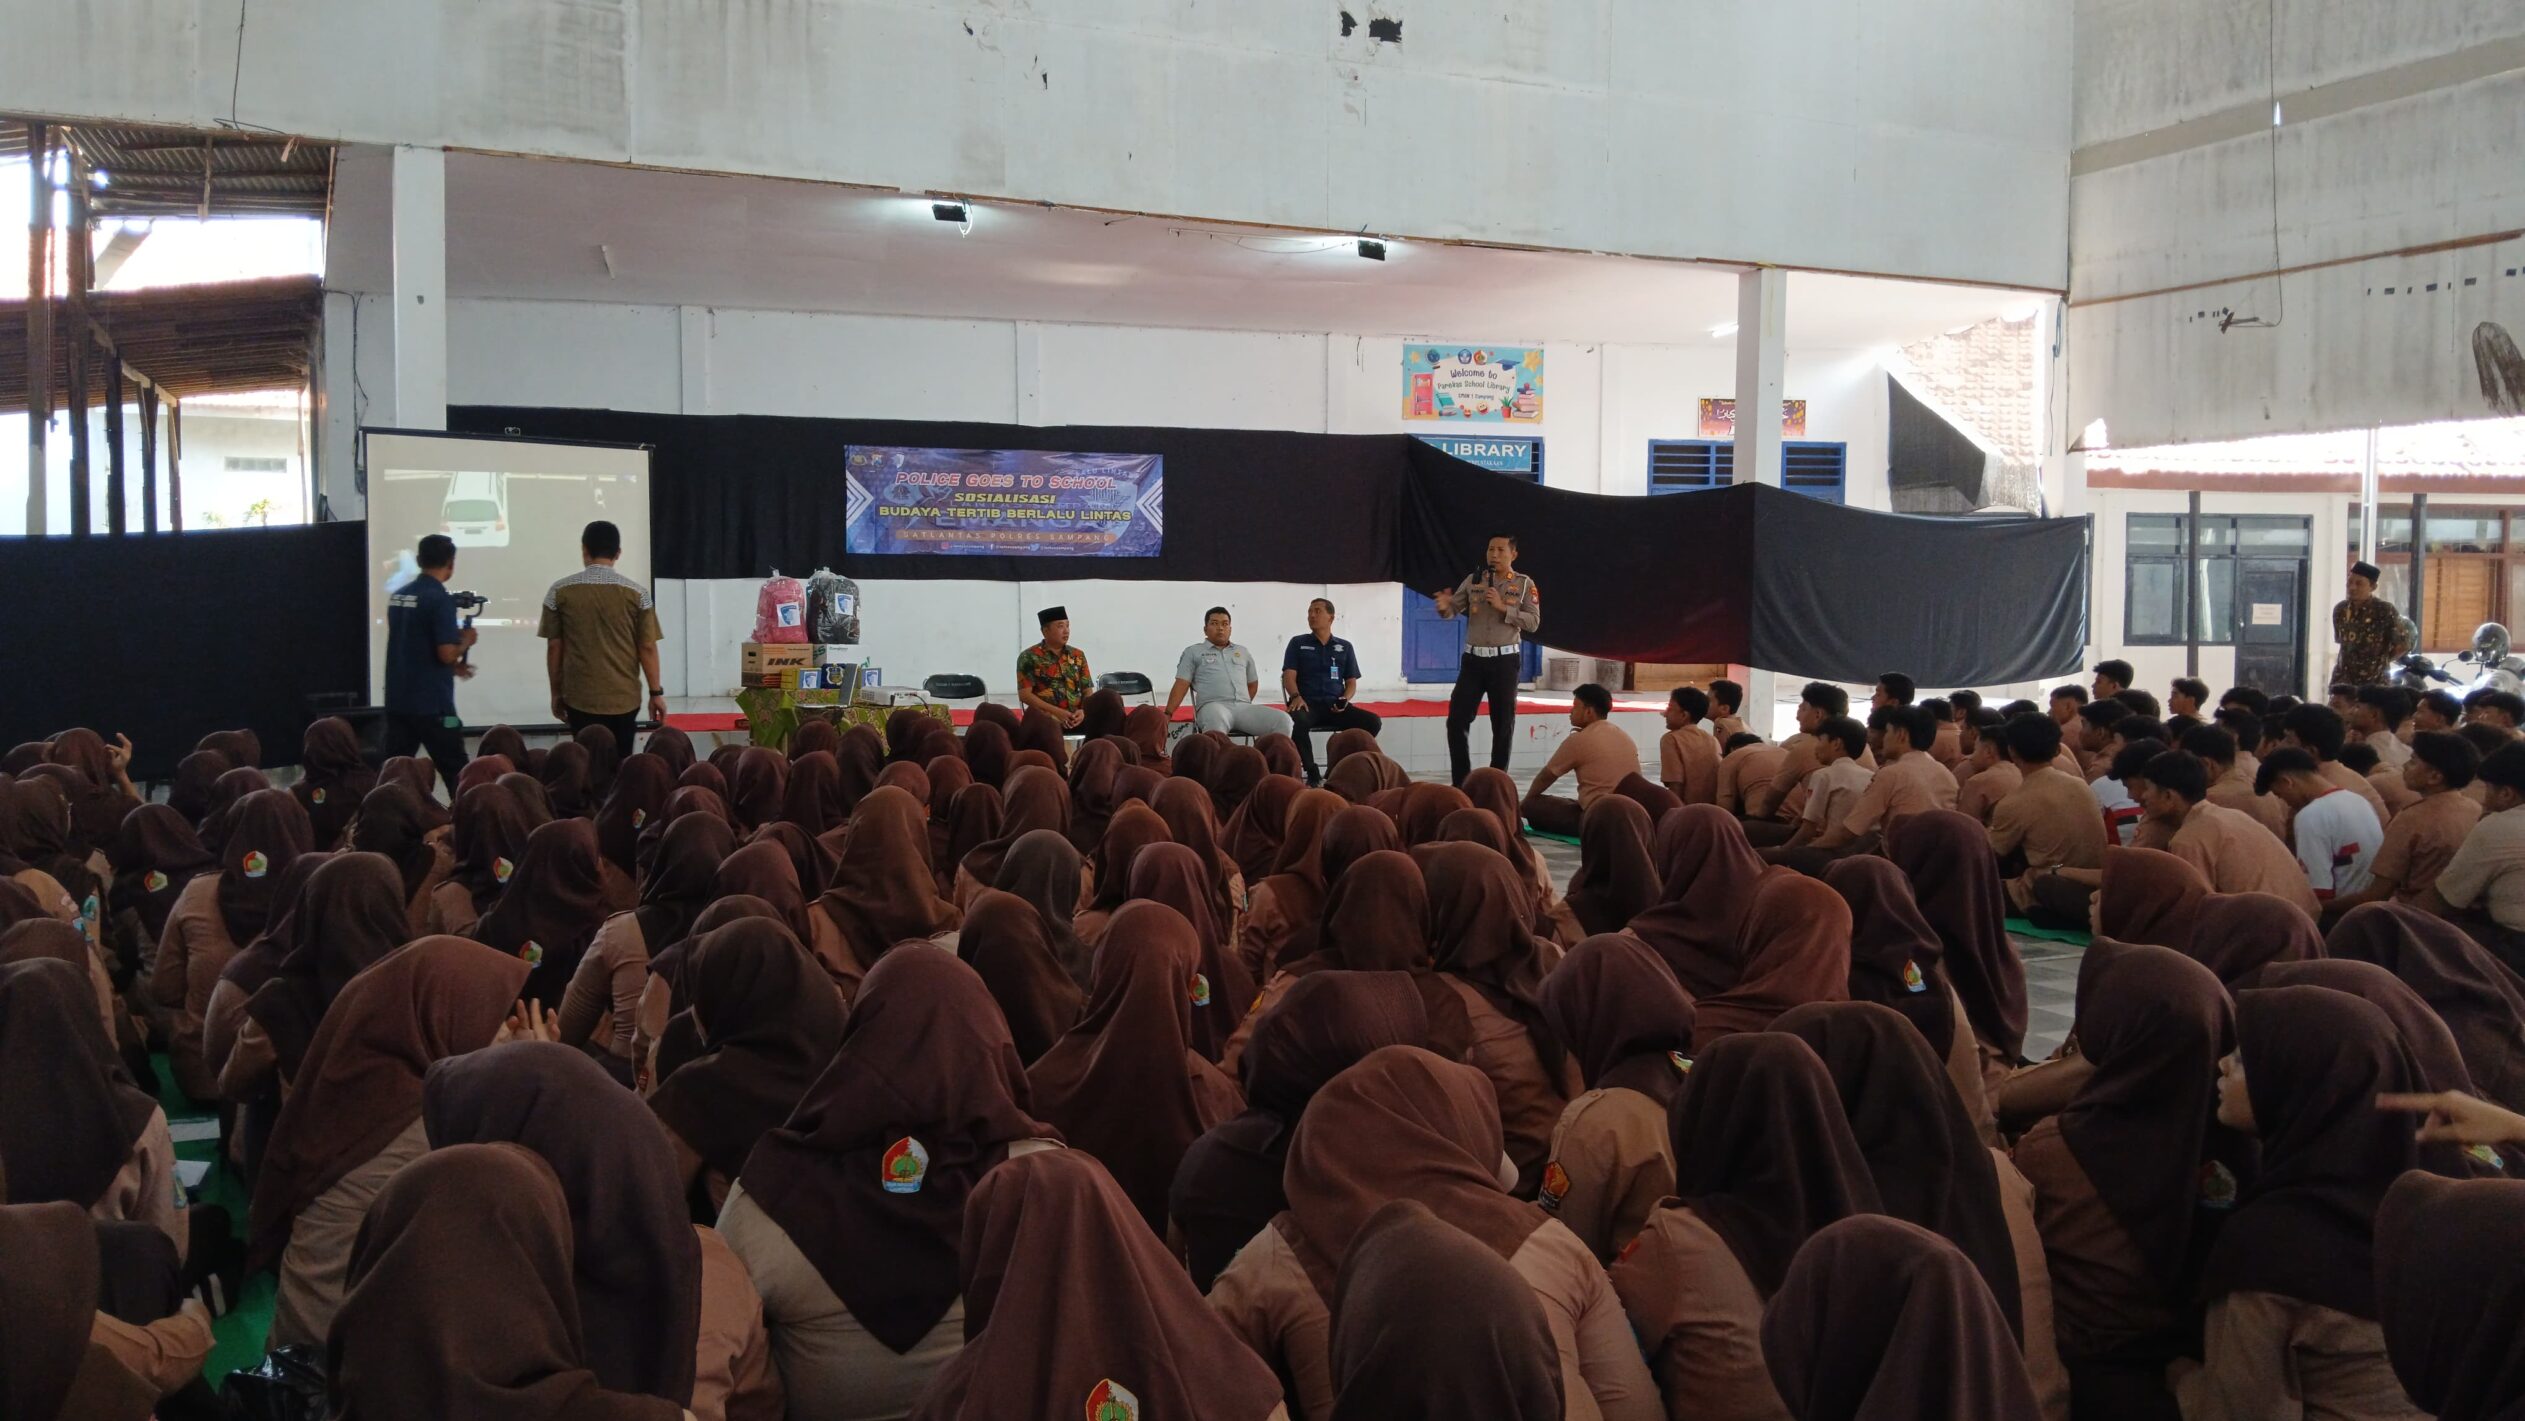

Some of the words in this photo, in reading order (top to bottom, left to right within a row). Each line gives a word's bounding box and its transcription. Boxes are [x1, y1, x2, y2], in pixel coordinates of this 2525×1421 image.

[1450, 369, 1485, 378] Welcome
[1488, 369, 1498, 380] to
[1464, 380, 1485, 388] School
[1487, 381, 1511, 394] Library
[1442, 442, 1527, 458] LIBRARY
[895, 471, 962, 487] POLICE
[965, 473, 1015, 488] GOES
[1020, 474, 1044, 488] TO
[1049, 475, 1118, 490] SCHOOL
[954, 492, 1056, 505] SOSIALISASI
[879, 506, 942, 518] BUDAYA
[946, 507, 1001, 519] TERTIB
[1006, 509, 1075, 520] BERLALU
[1080, 510, 1133, 522] LINTAS
[903, 531, 981, 539] SATLANTAS
[991, 532, 1041, 540] POLRES
[1049, 533, 1111, 542] SAMPANG
[767, 656, 806, 666] INK
